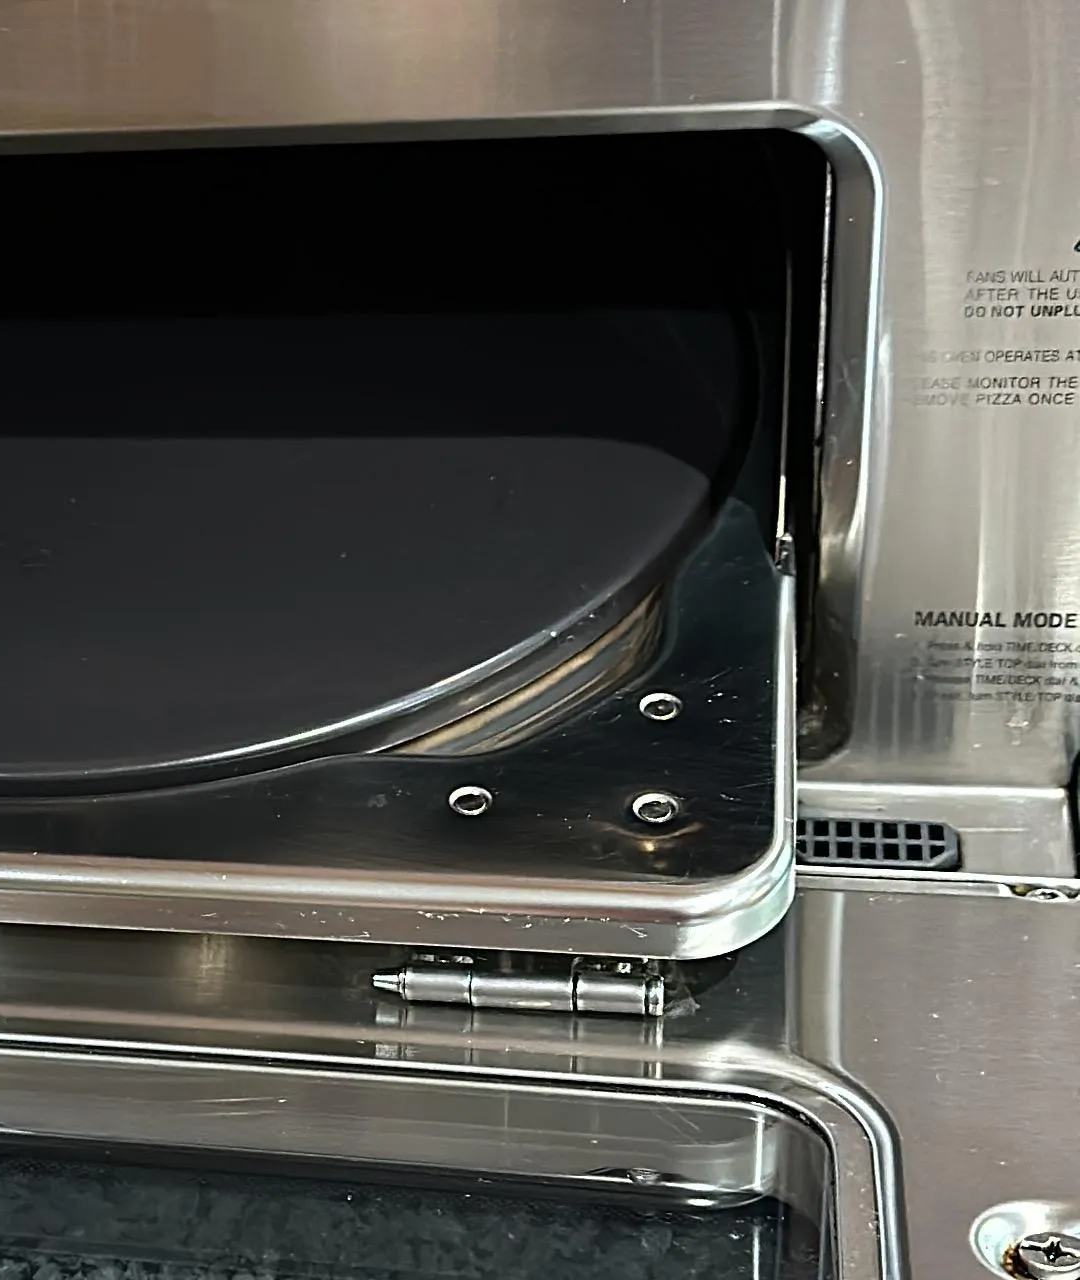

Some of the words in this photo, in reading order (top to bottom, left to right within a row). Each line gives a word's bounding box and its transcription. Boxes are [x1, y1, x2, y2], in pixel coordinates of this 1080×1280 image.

[1011, 269, 1046, 283] WILL
[965, 287, 1018, 301] AFTER
[1027, 287, 1059, 301] THE
[964, 304, 987, 318] DO
[990, 304, 1024, 318] NOT
[983, 349, 1060, 363] OPERATES
[965, 376, 1040, 390] MONITOR
[1048, 376, 1079, 389] THE
[975, 392, 1022, 406] PIZZA
[1028, 392, 1076, 405] ONCE
[914, 611, 1006, 628] MANUAL
[1013, 612, 1077, 628] MODE
